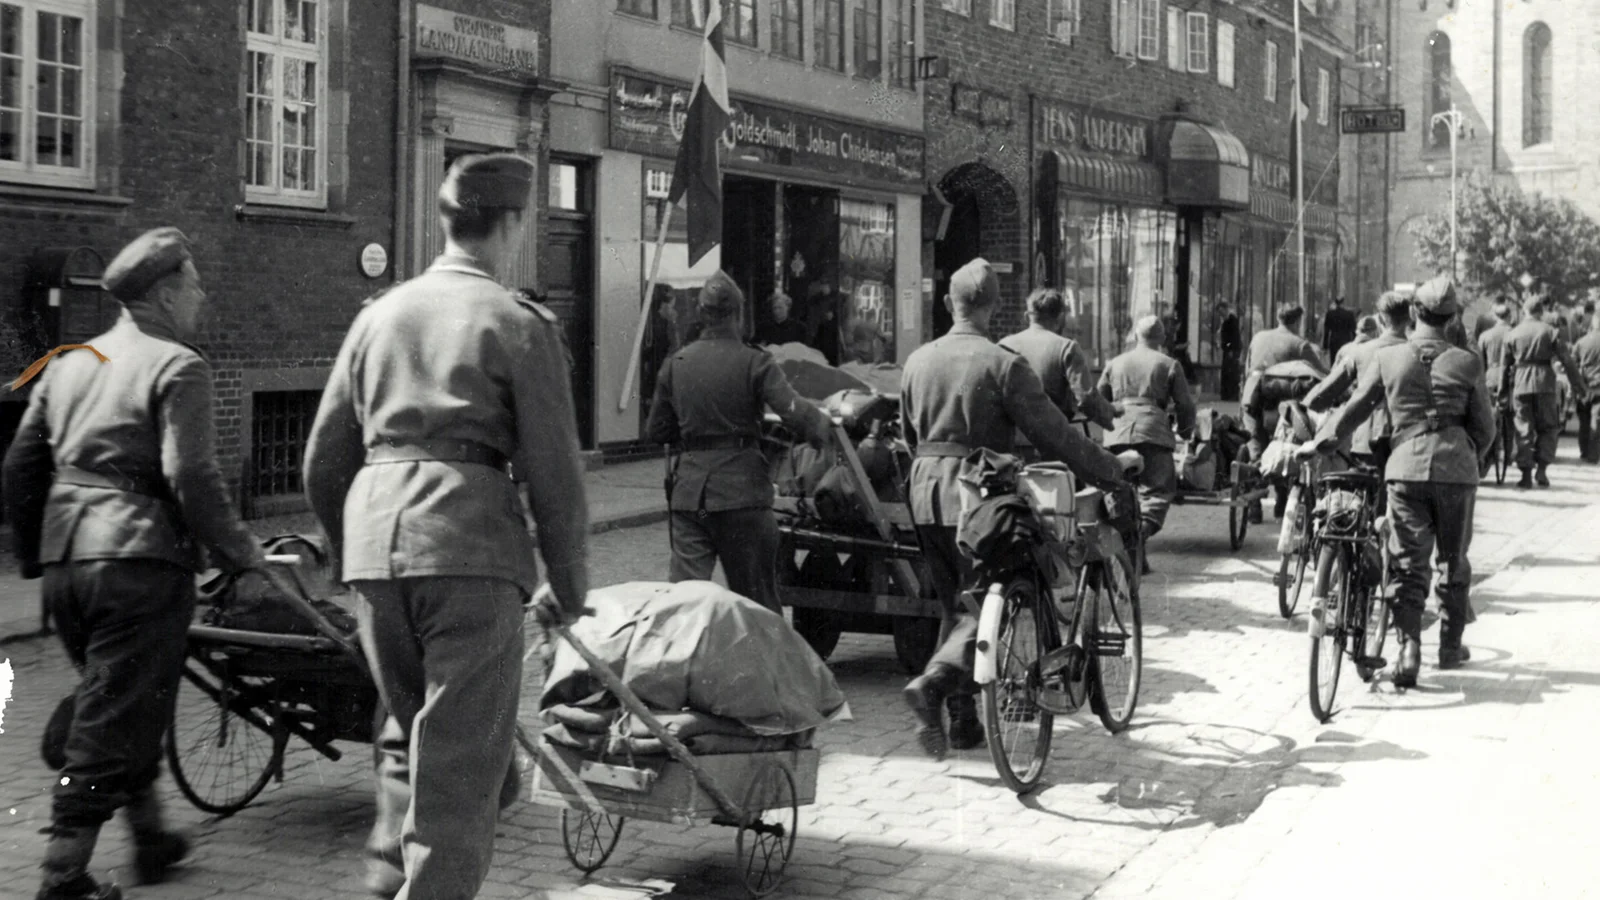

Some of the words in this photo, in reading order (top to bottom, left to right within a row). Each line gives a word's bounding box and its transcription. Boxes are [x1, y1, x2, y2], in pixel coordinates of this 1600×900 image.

[419, 25, 535, 70] LANDMANDSBANK
[806, 125, 837, 157] Johan
[840, 132, 896, 168] Christensen
[1082, 114, 1147, 155] ANDERSEN
